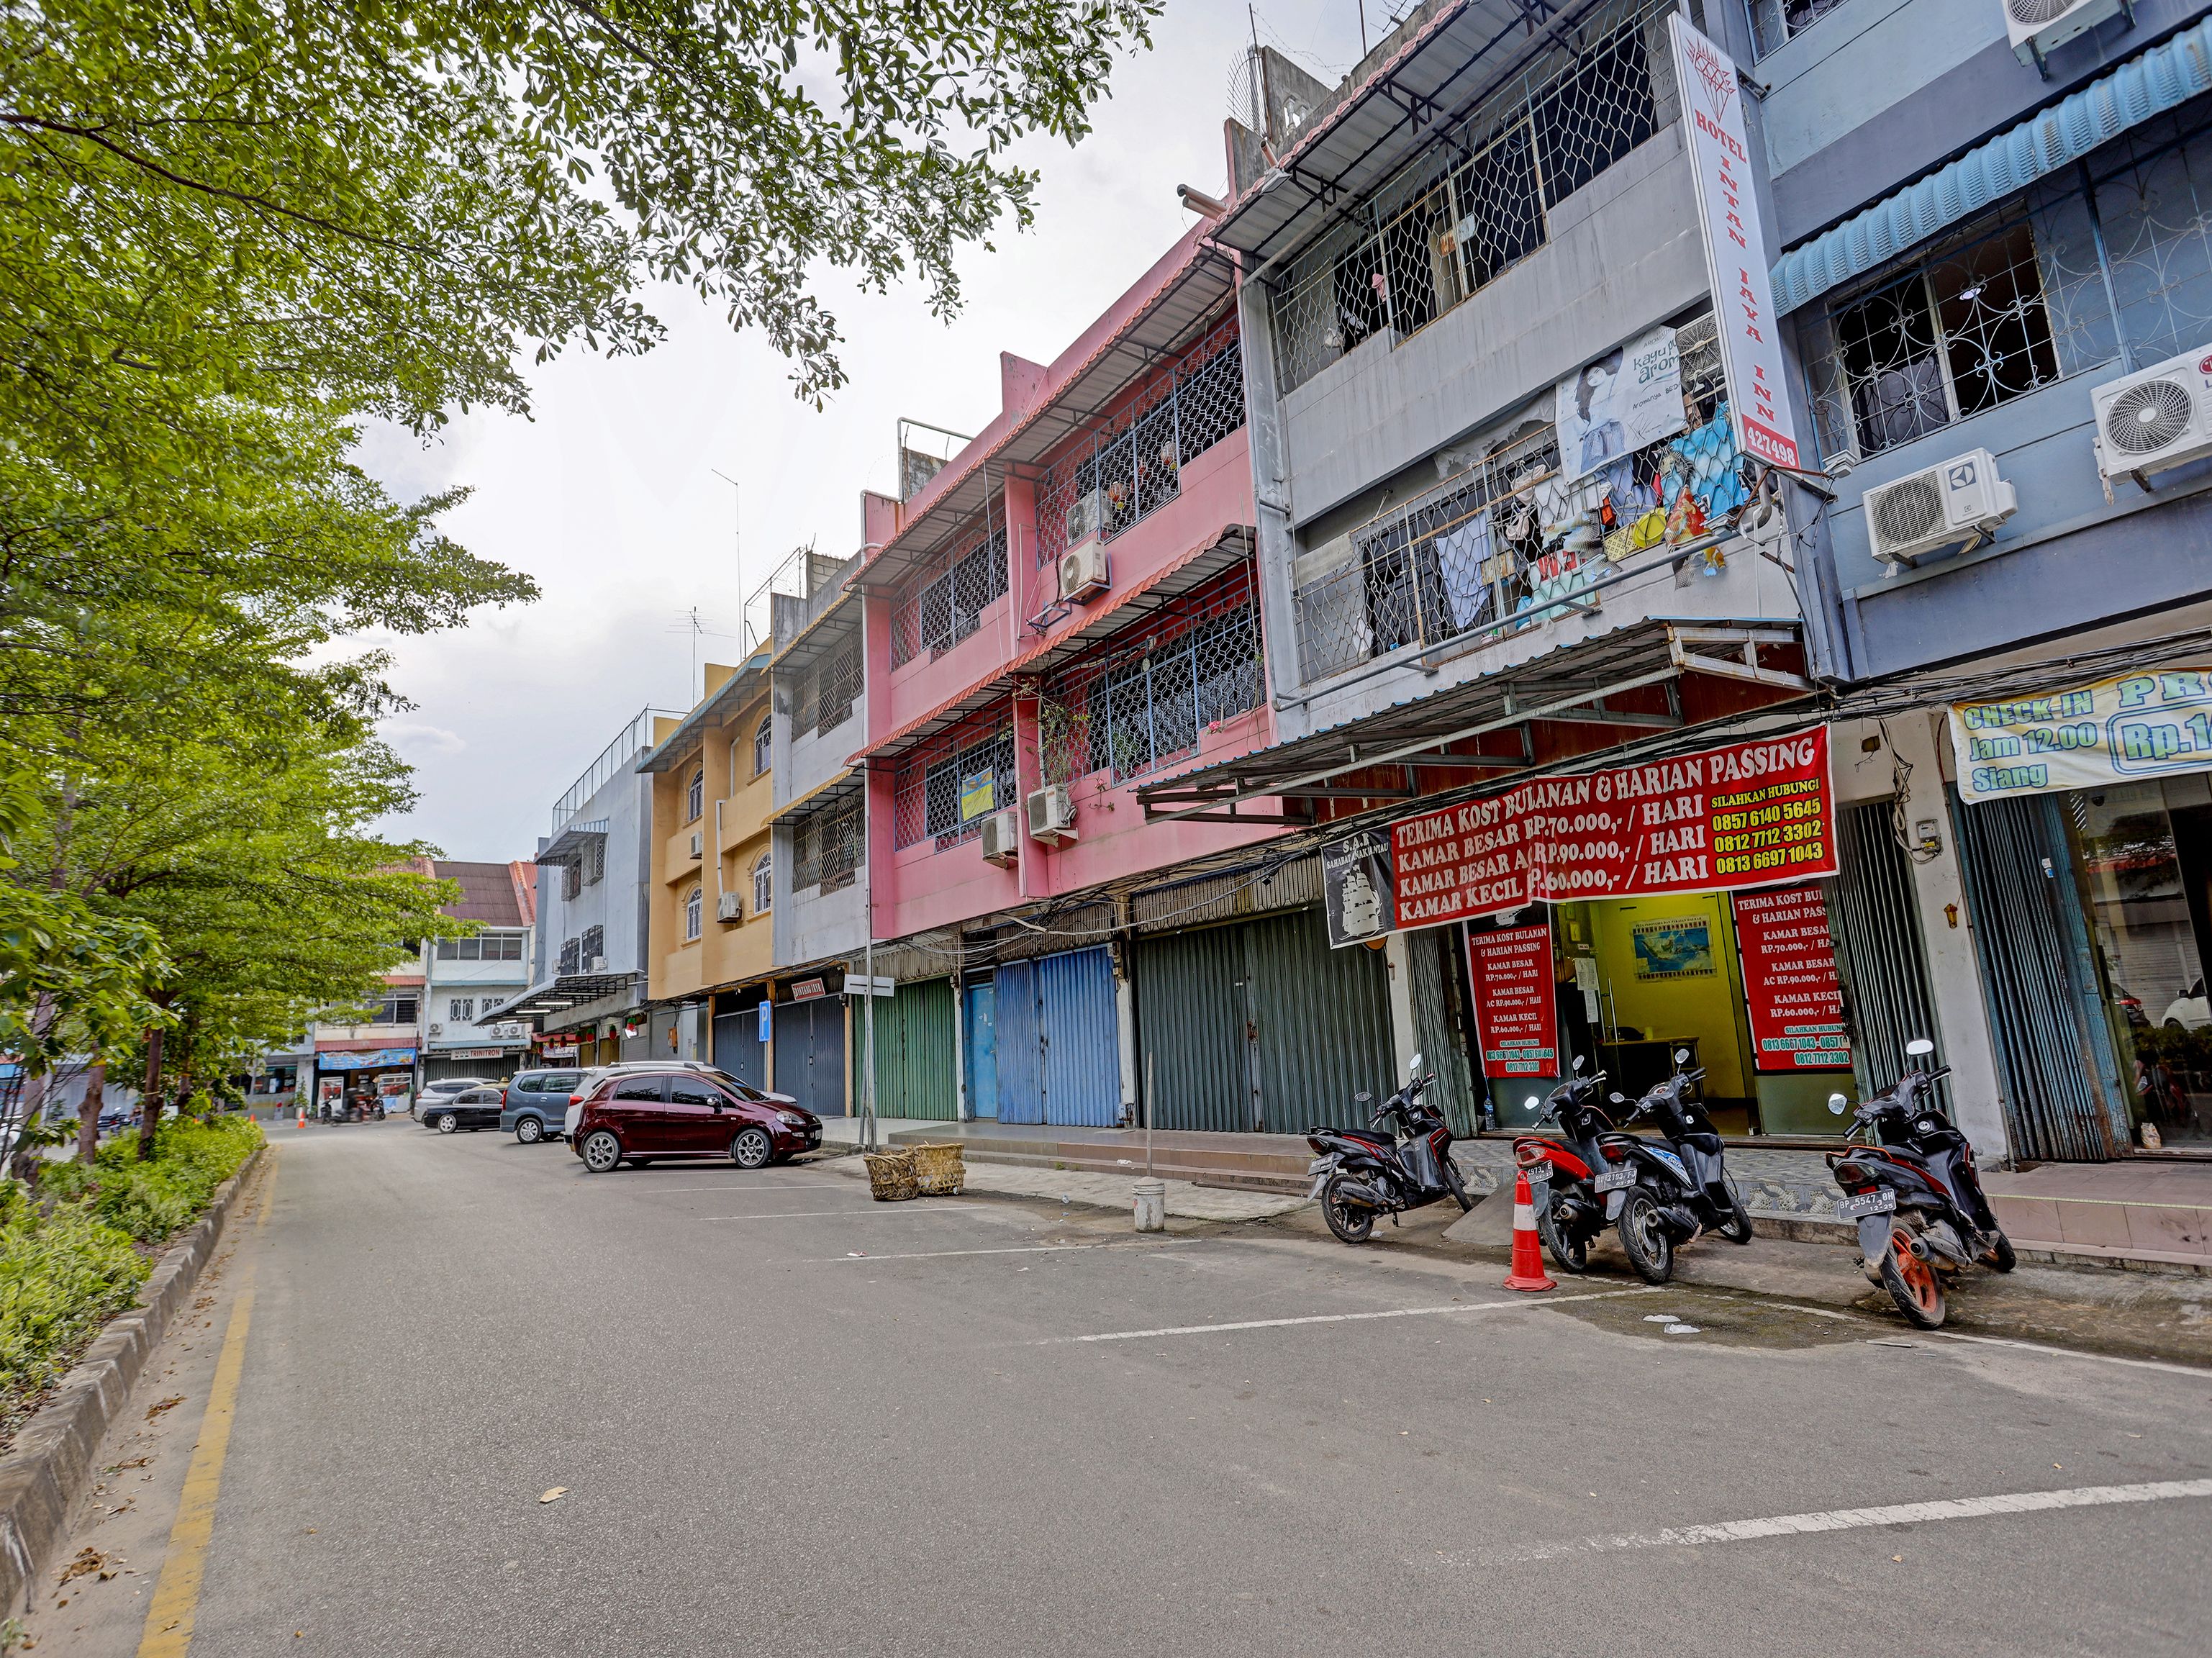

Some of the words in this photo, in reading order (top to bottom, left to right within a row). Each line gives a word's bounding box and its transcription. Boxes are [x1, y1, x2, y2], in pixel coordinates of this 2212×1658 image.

[1695, 109, 1746, 164] HOTEL
[1718, 155, 1746, 249] INTAN
[1633, 347, 1666, 371] kayu
[1633, 393, 1661, 410] Aromanya
[1753, 364, 1774, 422] INN
[1747, 426, 1796, 467] 427498
[2118, 671, 2212, 708] PR
[1964, 689, 2095, 730] CHECK-IN
[1970, 736, 2020, 761] Jam
[2022, 722, 2098, 754] 12.00
[1972, 764, 2049, 792] Siang
[1396, 813, 1455, 848] TERIMA
[1458, 799, 1501, 833] KOST
[1502, 777, 1591, 820] BULANAN
[1595, 776, 1612, 802] &
[1614, 758, 1703, 800] HARIAN
[1709, 737, 1815, 784] PASSING
[1711, 789, 1767, 809] SILAHKAN
[1767, 778, 1820, 799] HUBUNGI
[1712, 812, 1748, 832] 0857
[1749, 805, 1781, 827] 6140
[1782, 797, 1821, 820] 5645
[1398, 841, 1460, 873] KAMAR
[1464, 823, 1520, 858] BESAR
[1627, 805, 1636, 832] /
[1642, 794, 1704, 825] HARI
[1714, 832, 1750, 853] 0812
[1751, 827, 1781, 848] 7712
[1782, 819, 1822, 842] 3302
[1400, 869, 1456, 897] KAMAR
[1459, 853, 1510, 885] BESAR
[1635, 835, 1644, 861] /
[1650, 825, 1706, 856] HARI
[1715, 854, 1751, 874] 0813
[1753, 848, 1786, 869] 6697
[1787, 841, 1823, 863] 1043
[1400, 892, 1463, 921] KAMAR
[1466, 877, 1523, 908] KECIL
[1625, 864, 1638, 889] /
[1643, 855, 1709, 884] HARI
[1738, 897, 1774, 910] TERIMA
[1775, 892, 1803, 906] KOST
[1752, 914, 1760, 925] &
[1762, 908, 1801, 923] HARIAN
[1472, 936, 1495, 946] TERIMA
[1497, 932, 1514, 943] KOST
[1515, 928, 1547, 940] BULANAN
[1763, 928, 1798, 941] KAMAR
[1480, 948, 1485, 957] &
[1487, 946, 1512, 956] HARIAN
[1514, 942, 1541, 953] PASSING
[1487, 961, 1510, 971] KAMAR
[1512, 959, 1533, 969] BESAR
[1523, 969, 1538, 978] HARI
[1772, 961, 1804, 972] KAMAR
[1805, 957, 1835, 969] BESAR
[1763, 977, 1775, 986] AC
[1492, 987, 1514, 997] KAMAR
[1514, 986, 1534, 995] BESAR
[1774, 992, 1811, 1005] KAMAR
[1486, 1000, 1495, 1008] AC
[761, 1006, 768, 1037] P
[1493, 1014, 1517, 1023] KAMAR
[1518, 1013, 1538, 1021] KECIL
[1785, 1025, 1818, 1035] SILAHKAN
[471, 1048, 500, 1057] TRINITRON
[1762, 1038, 1780, 1051] 0813
[1798, 1036, 1816, 1050] 1043
[1820, 1036, 1839, 1048] 0857
[1795, 1052, 1813, 1065] 0812
[1829, 1051, 1850, 1064] 3302
[1839, 1200, 1850, 1209] BP
[1854, 1195, 1876, 1206] 5547
